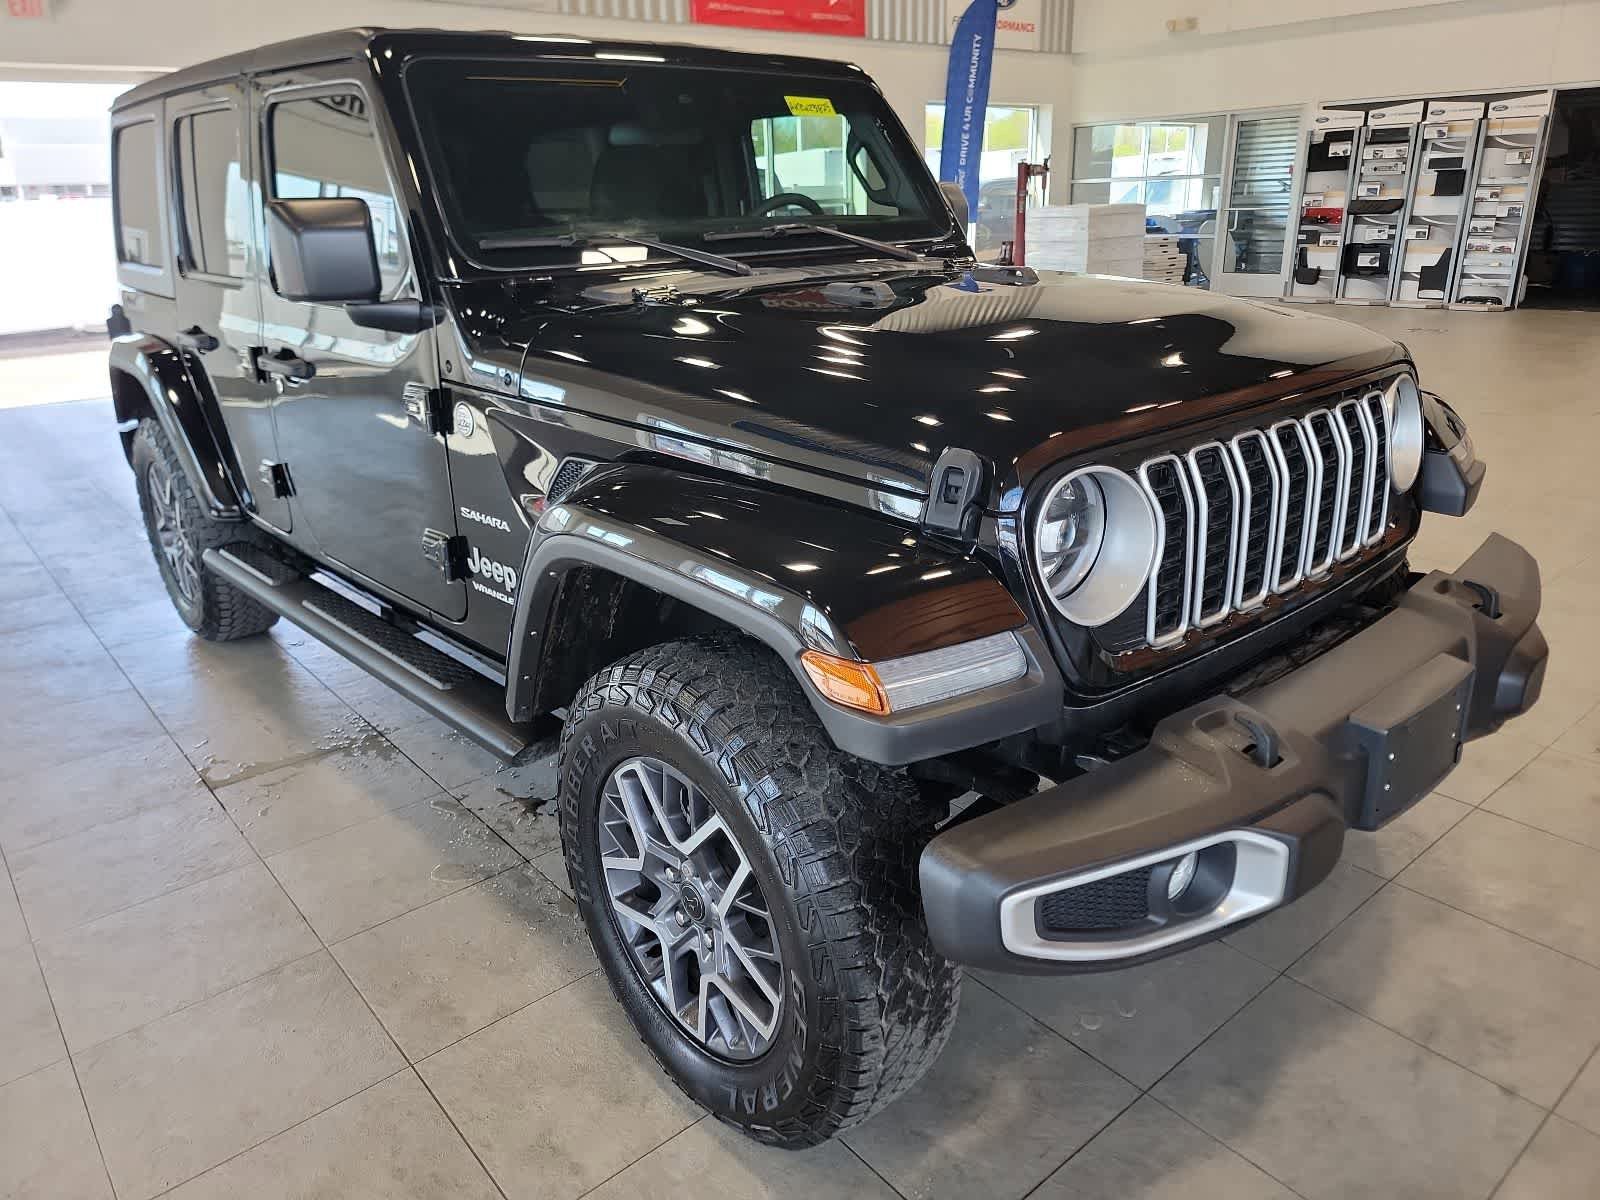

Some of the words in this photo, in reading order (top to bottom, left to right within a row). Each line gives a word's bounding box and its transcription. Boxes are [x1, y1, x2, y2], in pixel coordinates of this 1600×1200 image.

[996, 19, 1036, 32] ORMANCE
[959, 133, 971, 165] DRIVE
[460, 506, 511, 533] SAHARA
[467, 546, 517, 593] Jeep
[472, 580, 515, 606] WRANGLE
[720, 969, 807, 1115] GENERAL
